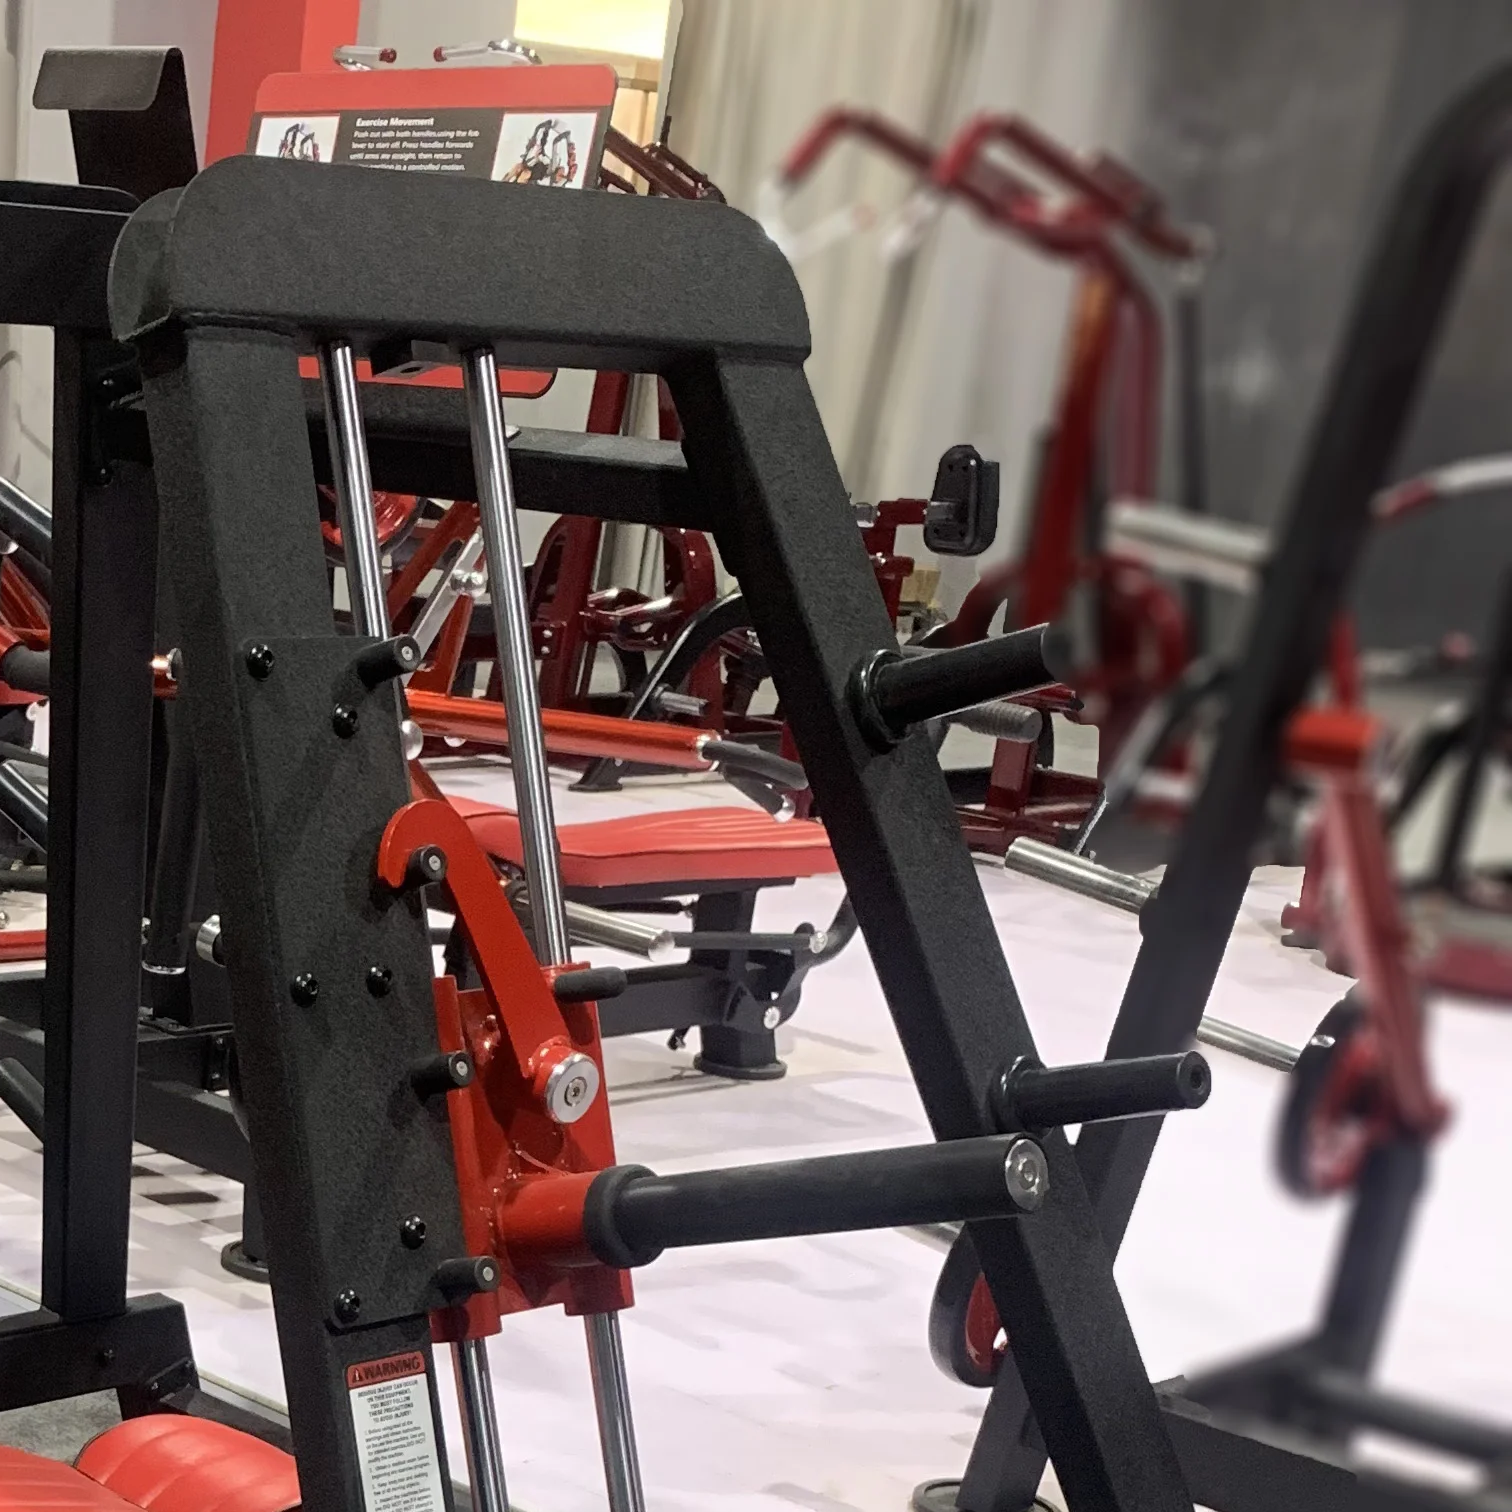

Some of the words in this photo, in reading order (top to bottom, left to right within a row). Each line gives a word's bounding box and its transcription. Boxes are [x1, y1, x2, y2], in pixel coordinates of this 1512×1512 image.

[356, 117, 388, 127] Exercise
[389, 117, 434, 126] Movement
[364, 1356, 421, 1379] WARNING
